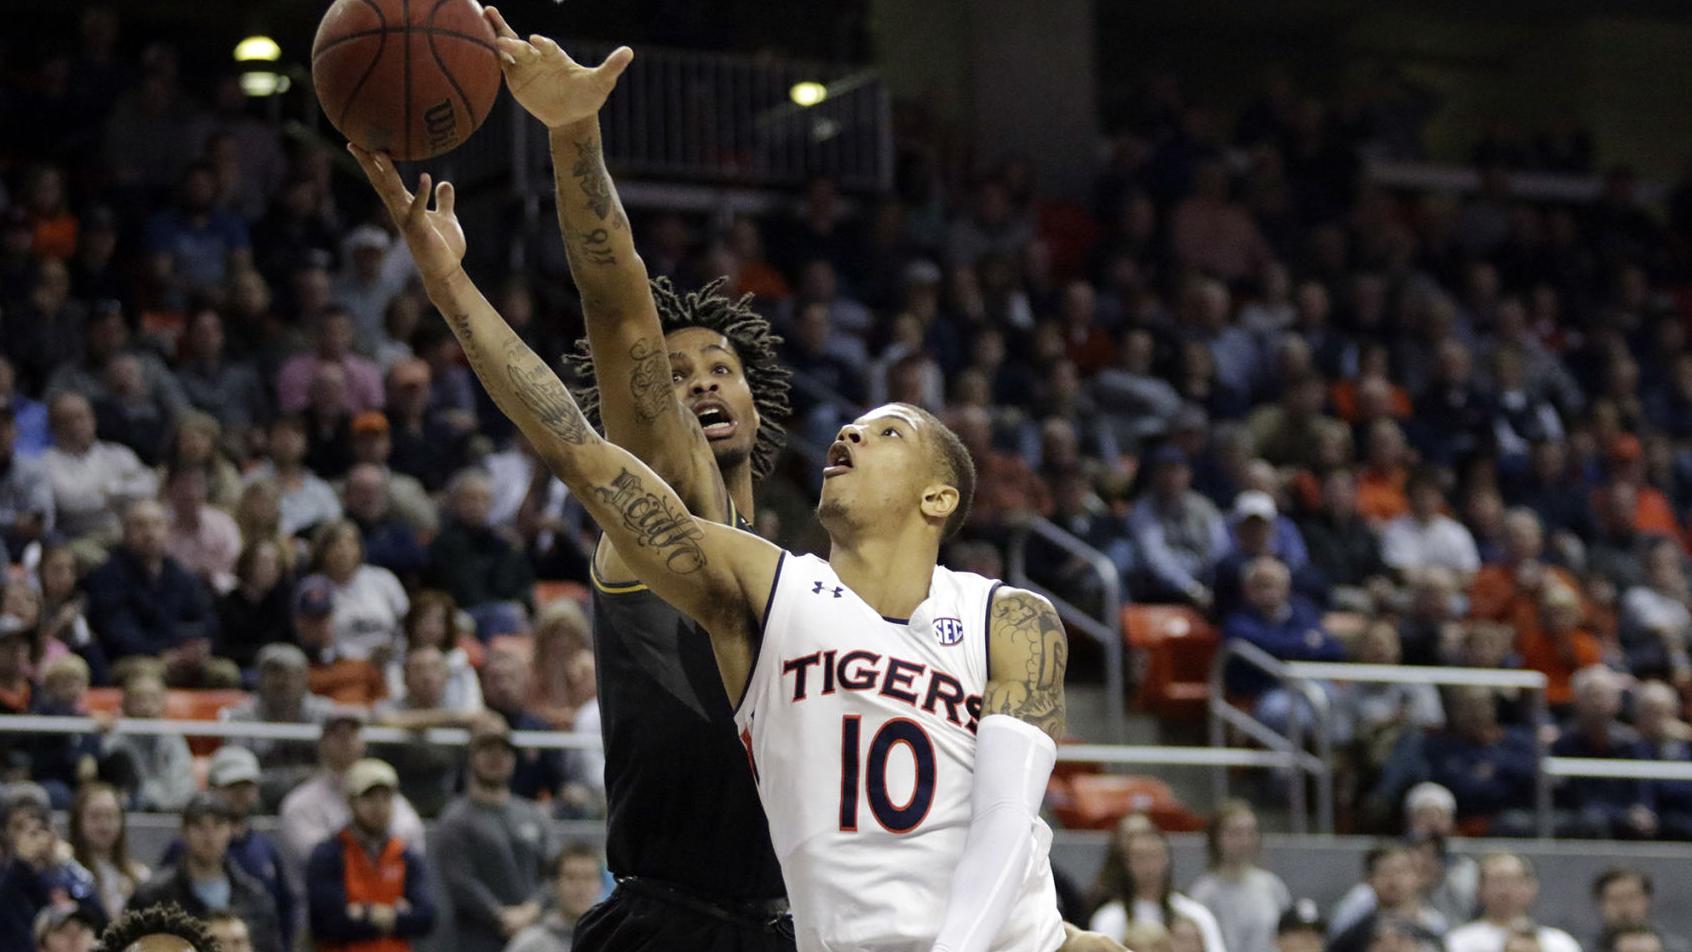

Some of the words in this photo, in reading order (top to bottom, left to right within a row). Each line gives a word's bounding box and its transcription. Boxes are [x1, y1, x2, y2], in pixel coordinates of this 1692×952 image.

[932, 617, 964, 646] SEC
[783, 650, 983, 735] TIGERS
[839, 714, 937, 834] 10
